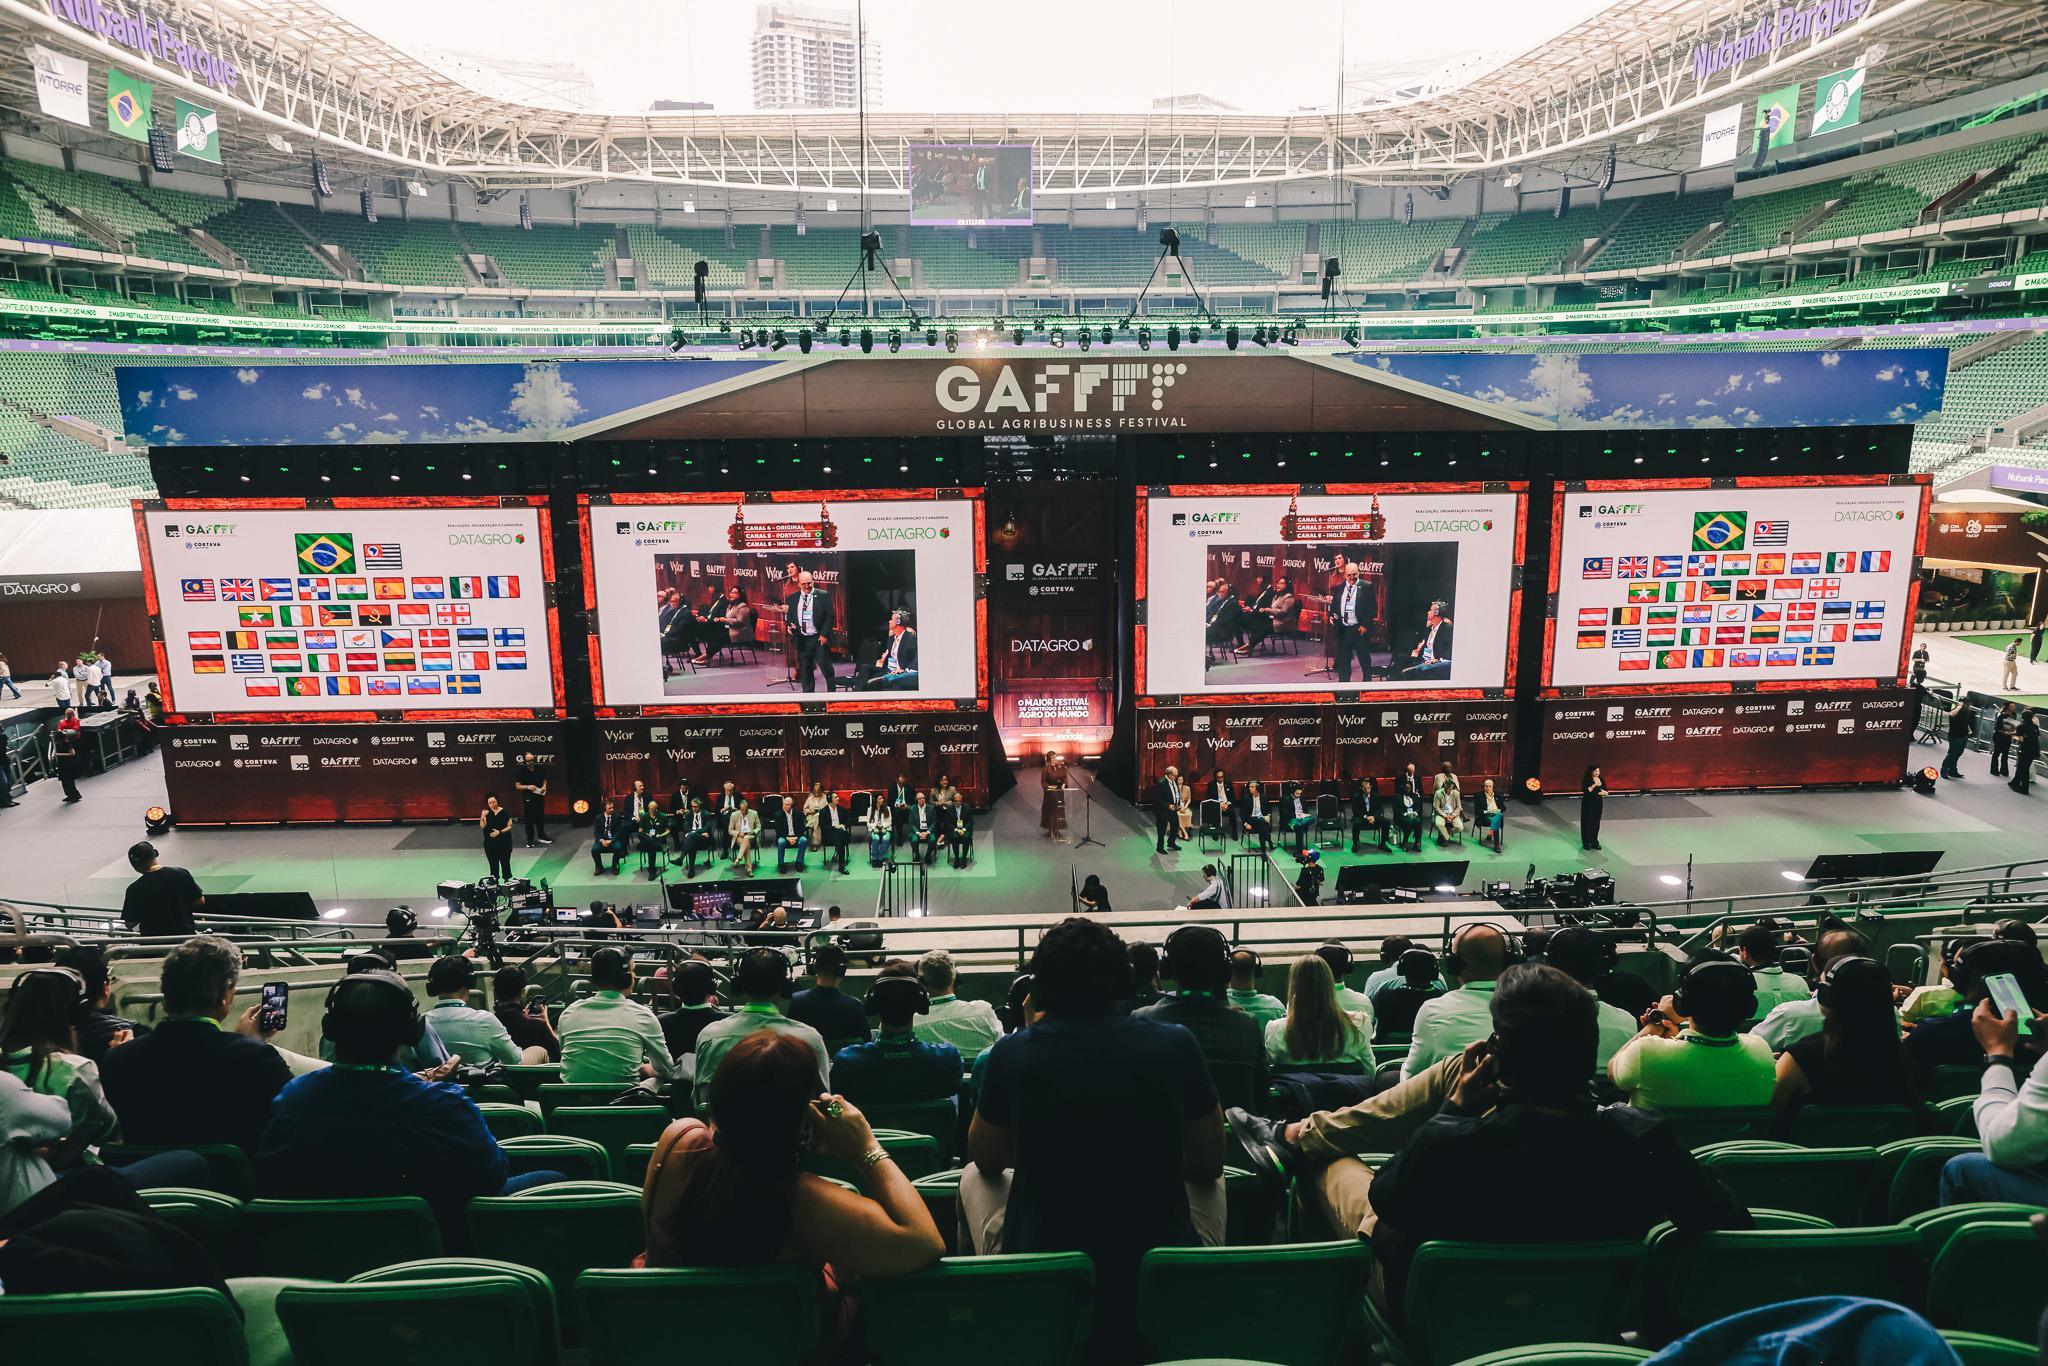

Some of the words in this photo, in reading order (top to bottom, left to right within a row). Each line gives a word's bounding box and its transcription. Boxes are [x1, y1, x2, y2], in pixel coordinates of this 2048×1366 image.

[1692, 16, 1773, 80] Nubank
[1776, 0, 1868, 47] Parque
[157, 17, 238, 87] Parque
[38, 73, 83, 96] WTORRE
[1705, 125, 1736, 143] WTORRE
[936, 364, 1187, 413] GAFFFF
[936, 419, 995, 430] GLOBAL
[1002, 418, 1112, 429] AGRIBUSINESS
[1120, 417, 1187, 428] FESTIVAL
[2008, 472, 2034, 483] Nubank
[1834, 511, 1892, 522] DATAGRO
[1414, 520, 1480, 532] DATAGRO
[448, 534, 512, 545] DATAGRO
[868, 527, 936, 540] DATAGRO
[1032, 563, 1098, 576] GAFFFF
[4, 584, 68, 595] DATAGRO
[1011, 639, 1079, 652] DATAGRO
[1054, 698, 1089, 706] FESTIVAL
[1635, 708, 1671, 716] GAFFFF
[1815, 702, 1851, 710] GAFFFF
[1148, 719, 1176, 732] Vylor
[1338, 715, 1366, 727] Vylor
[1414, 713, 1451, 721] GAFFFF
[1686, 727, 1722, 735] GAFFFF
[1866, 720, 1902, 728] GAFFFF
[261, 737, 300, 745] GAFFFF
[458, 734, 496, 742] GAFFFF
[605, 730, 634, 742] Vylor
[800, 726, 829, 738] Vylor
[1207, 738, 1235, 750] Vylor
[1283, 737, 1321, 745] GAFFFF
[1395, 733, 1422, 746] Vylor
[667, 749, 696, 762] Vylor
[746, 749, 784, 757] GAFFFF
[861, 745, 890, 758] Vylor
[940, 744, 978, 752] GAFFFF
[321, 757, 360, 765] GAFFFF
